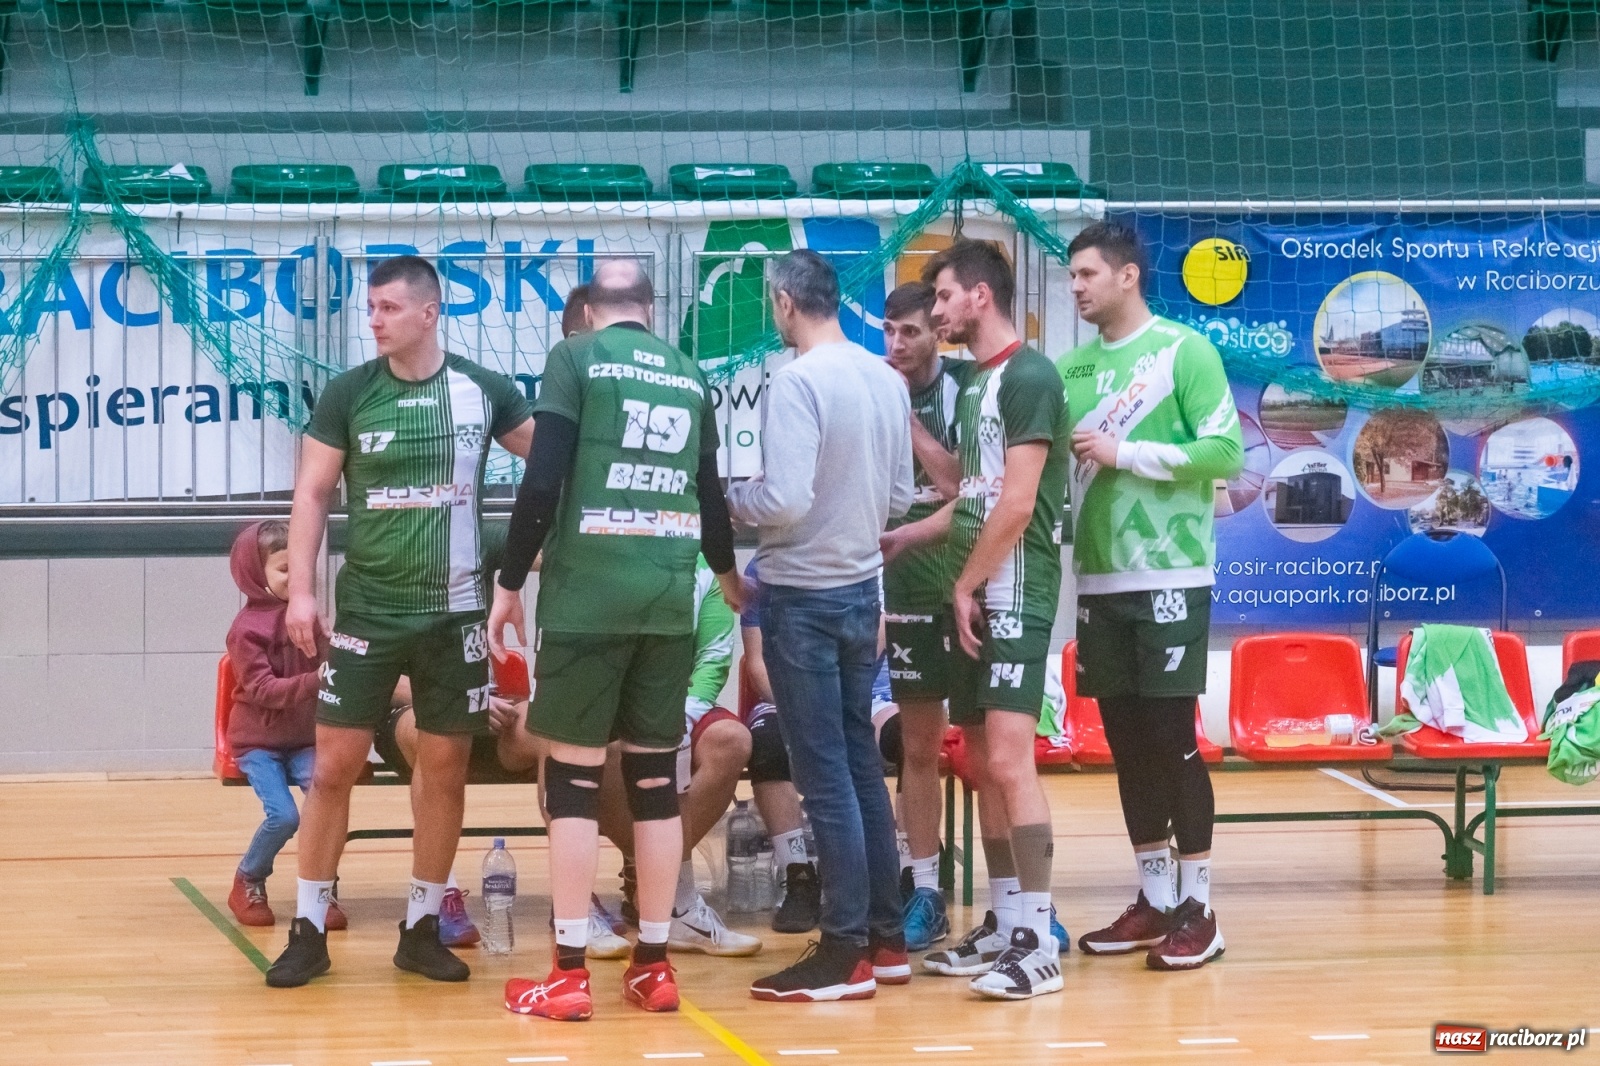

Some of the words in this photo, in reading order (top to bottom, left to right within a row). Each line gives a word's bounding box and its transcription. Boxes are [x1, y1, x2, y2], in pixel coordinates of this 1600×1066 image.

[1280, 237, 1383, 260] Ośrodek
[1391, 237, 1469, 262] Sportu
[1478, 240, 1484, 259] i
[1456, 275, 1477, 291] w
[1096, 369, 1116, 395] 12
[621, 398, 692, 454] 19
[358, 431, 396, 453] 17
[605, 462, 689, 495] BERA
[1164, 645, 1186, 672] 7
[989, 663, 1025, 689] 14
